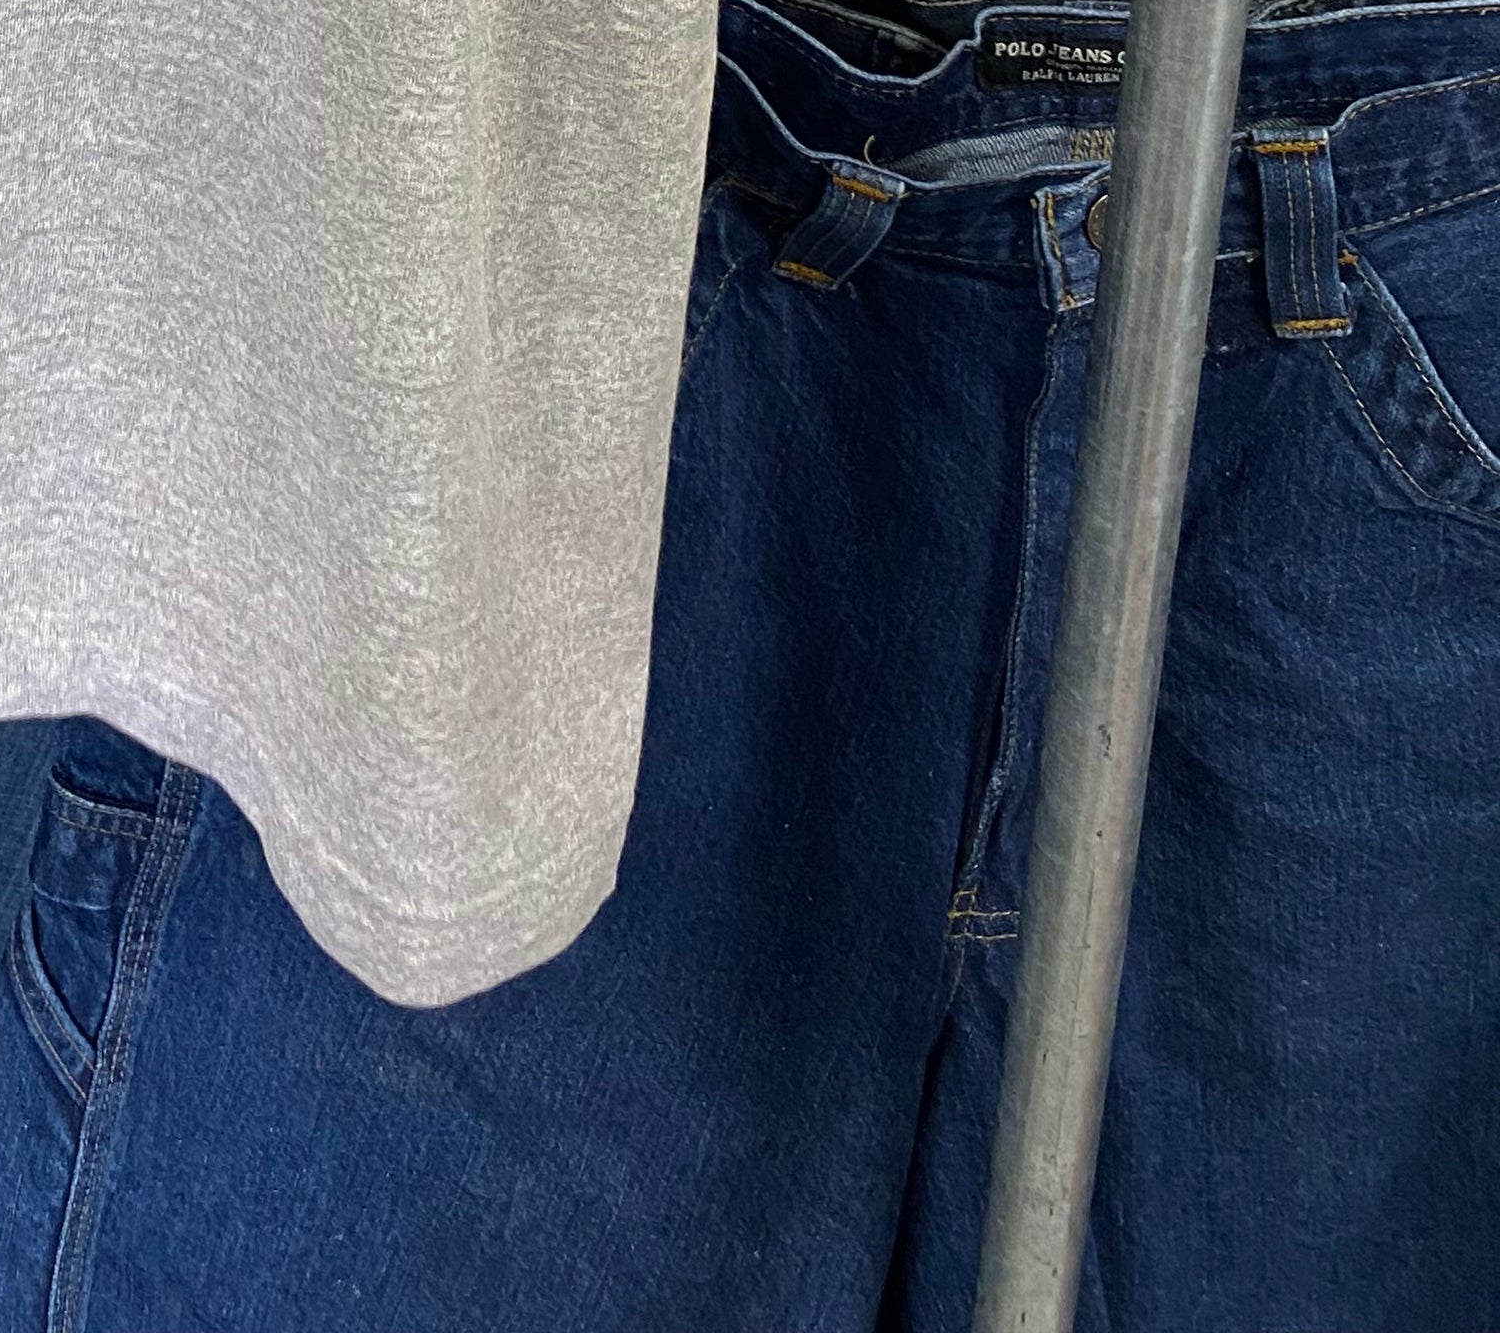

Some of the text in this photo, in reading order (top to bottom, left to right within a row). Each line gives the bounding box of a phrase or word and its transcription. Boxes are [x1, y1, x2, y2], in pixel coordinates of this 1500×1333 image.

[994, 41, 1045, 57] POLO
[1049, 43, 1112, 64] JEANS
[1068, 71, 1120, 83] LAUREN
